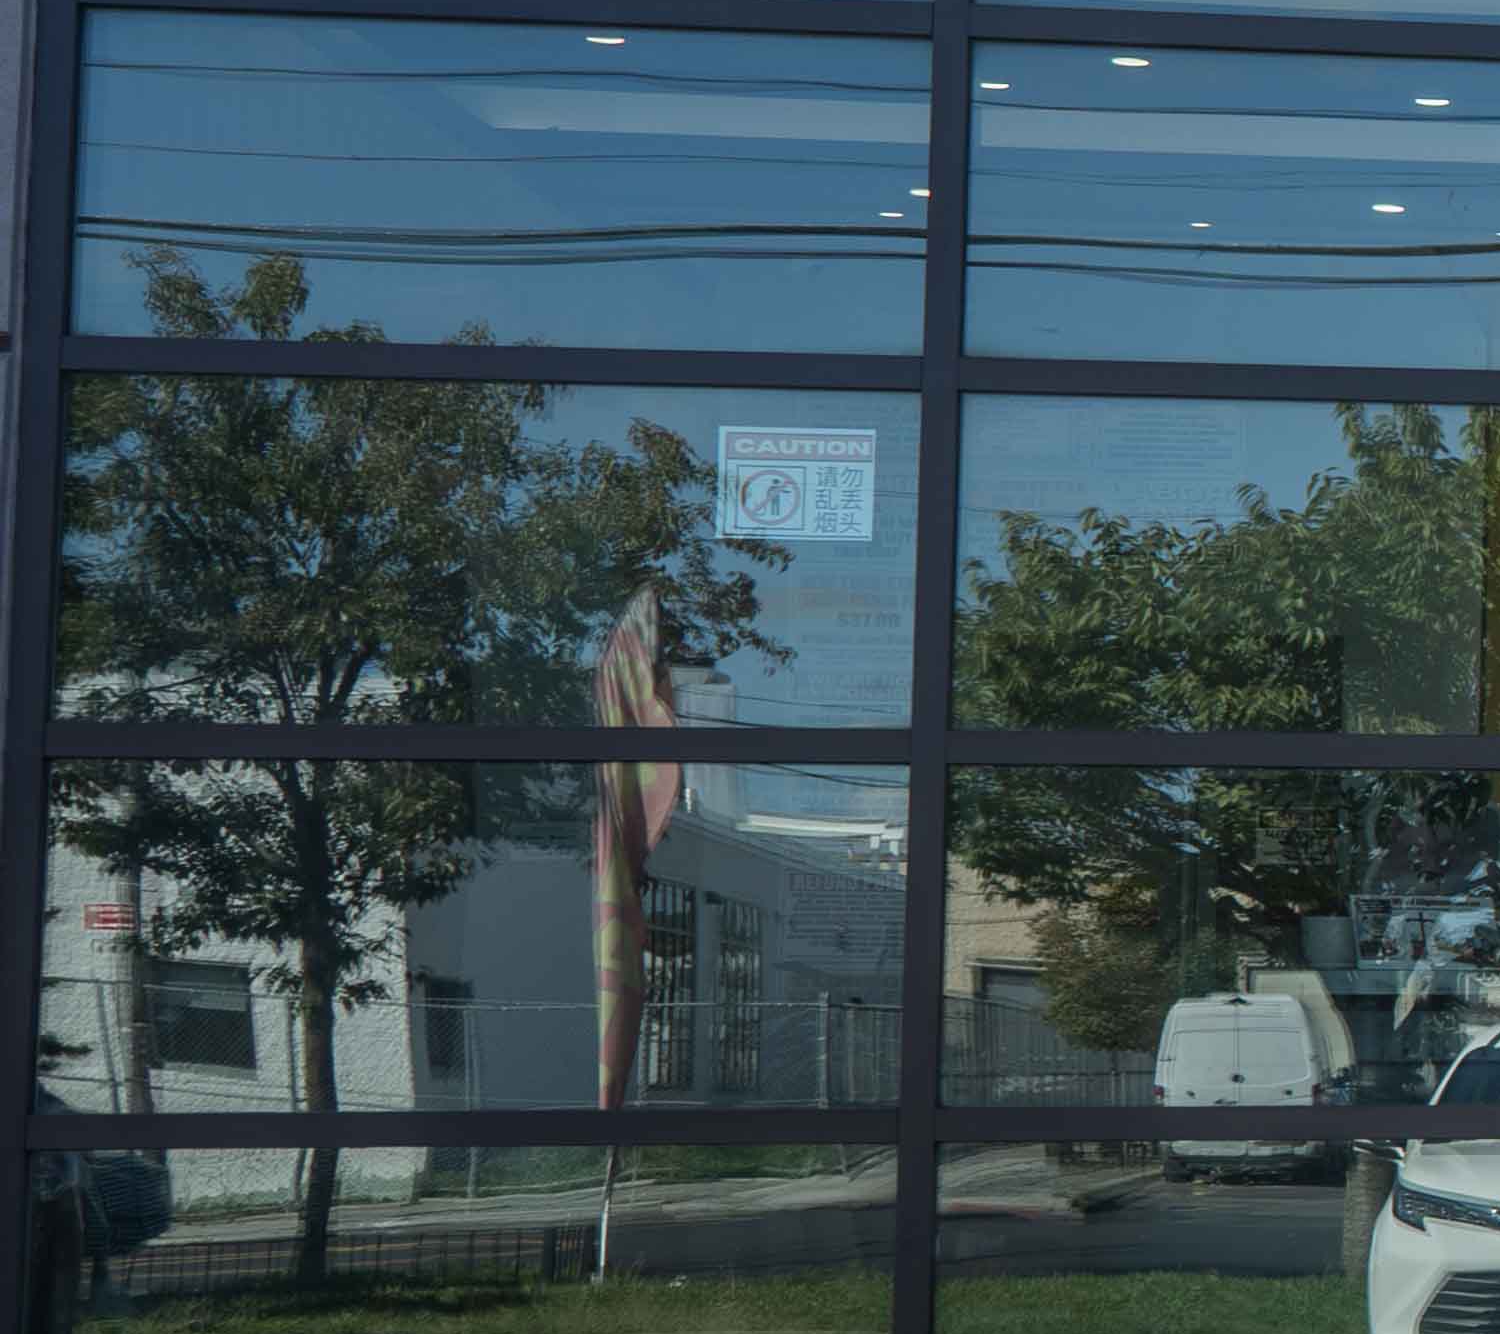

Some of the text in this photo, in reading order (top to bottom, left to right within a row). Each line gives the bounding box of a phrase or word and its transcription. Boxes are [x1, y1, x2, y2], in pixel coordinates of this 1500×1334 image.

[733, 438, 871, 457] CAUTION
[815, 466, 864, 488] 请勿
[815, 489, 865, 511] 乱丢
[813, 512, 864, 534] 烟头
